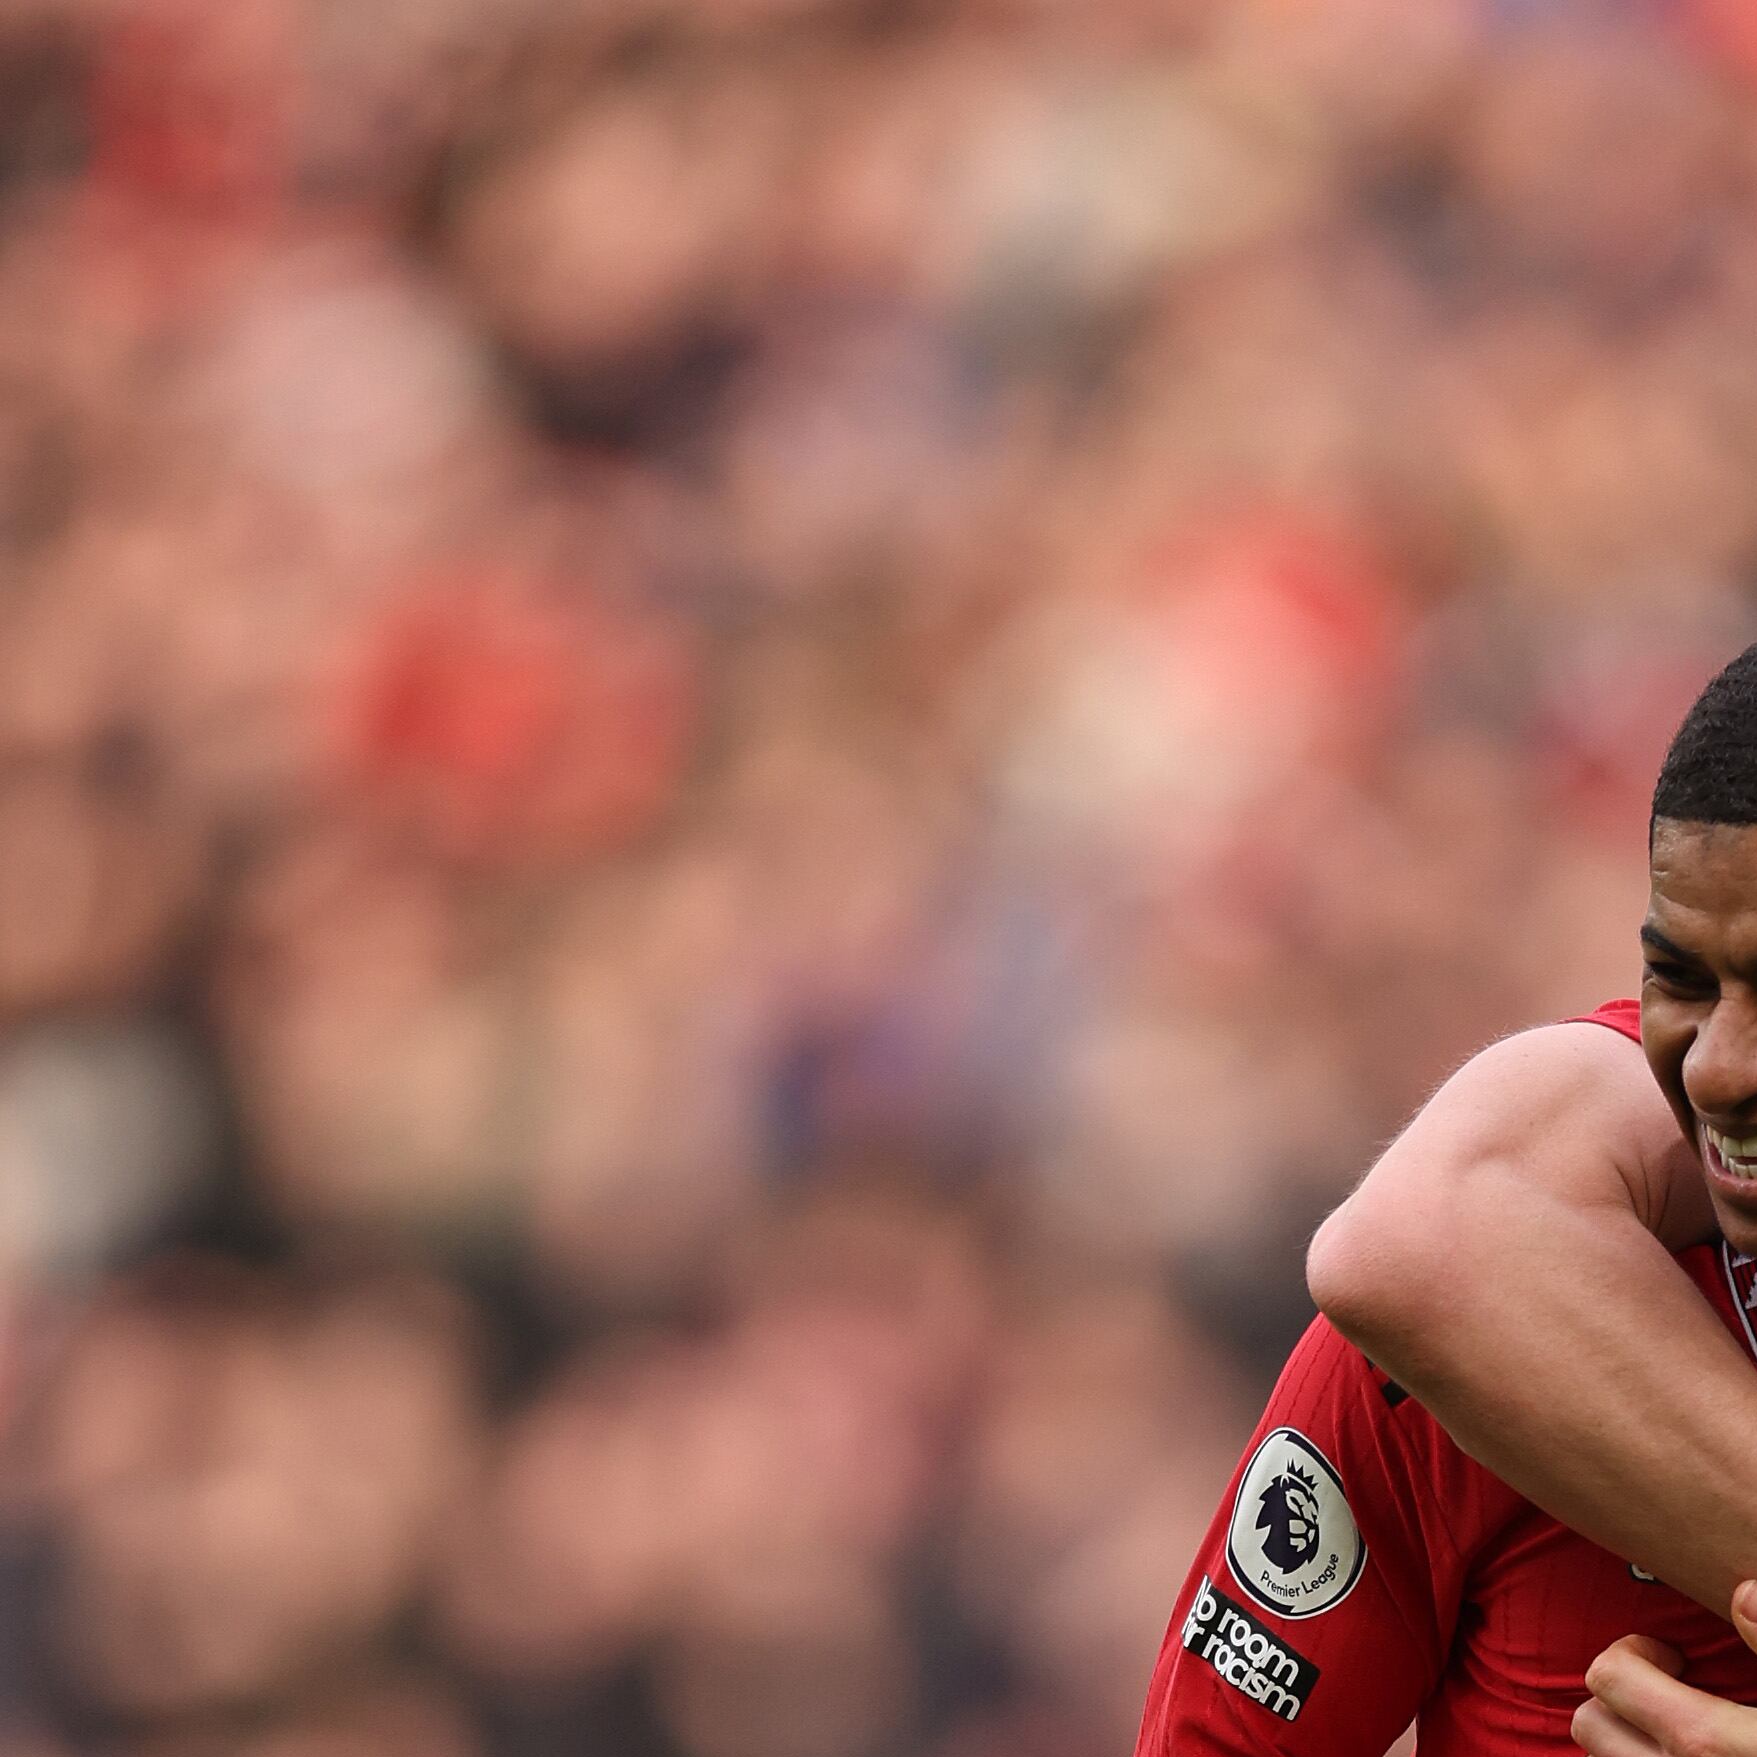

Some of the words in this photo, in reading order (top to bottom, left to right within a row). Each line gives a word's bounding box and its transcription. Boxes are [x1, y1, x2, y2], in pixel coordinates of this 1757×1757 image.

[1260, 1569, 1300, 1598] Premier
[1301, 1553, 1339, 1594] League
[1201, 1634, 1301, 1722] racism
[1217, 1608, 1300, 1688] room
